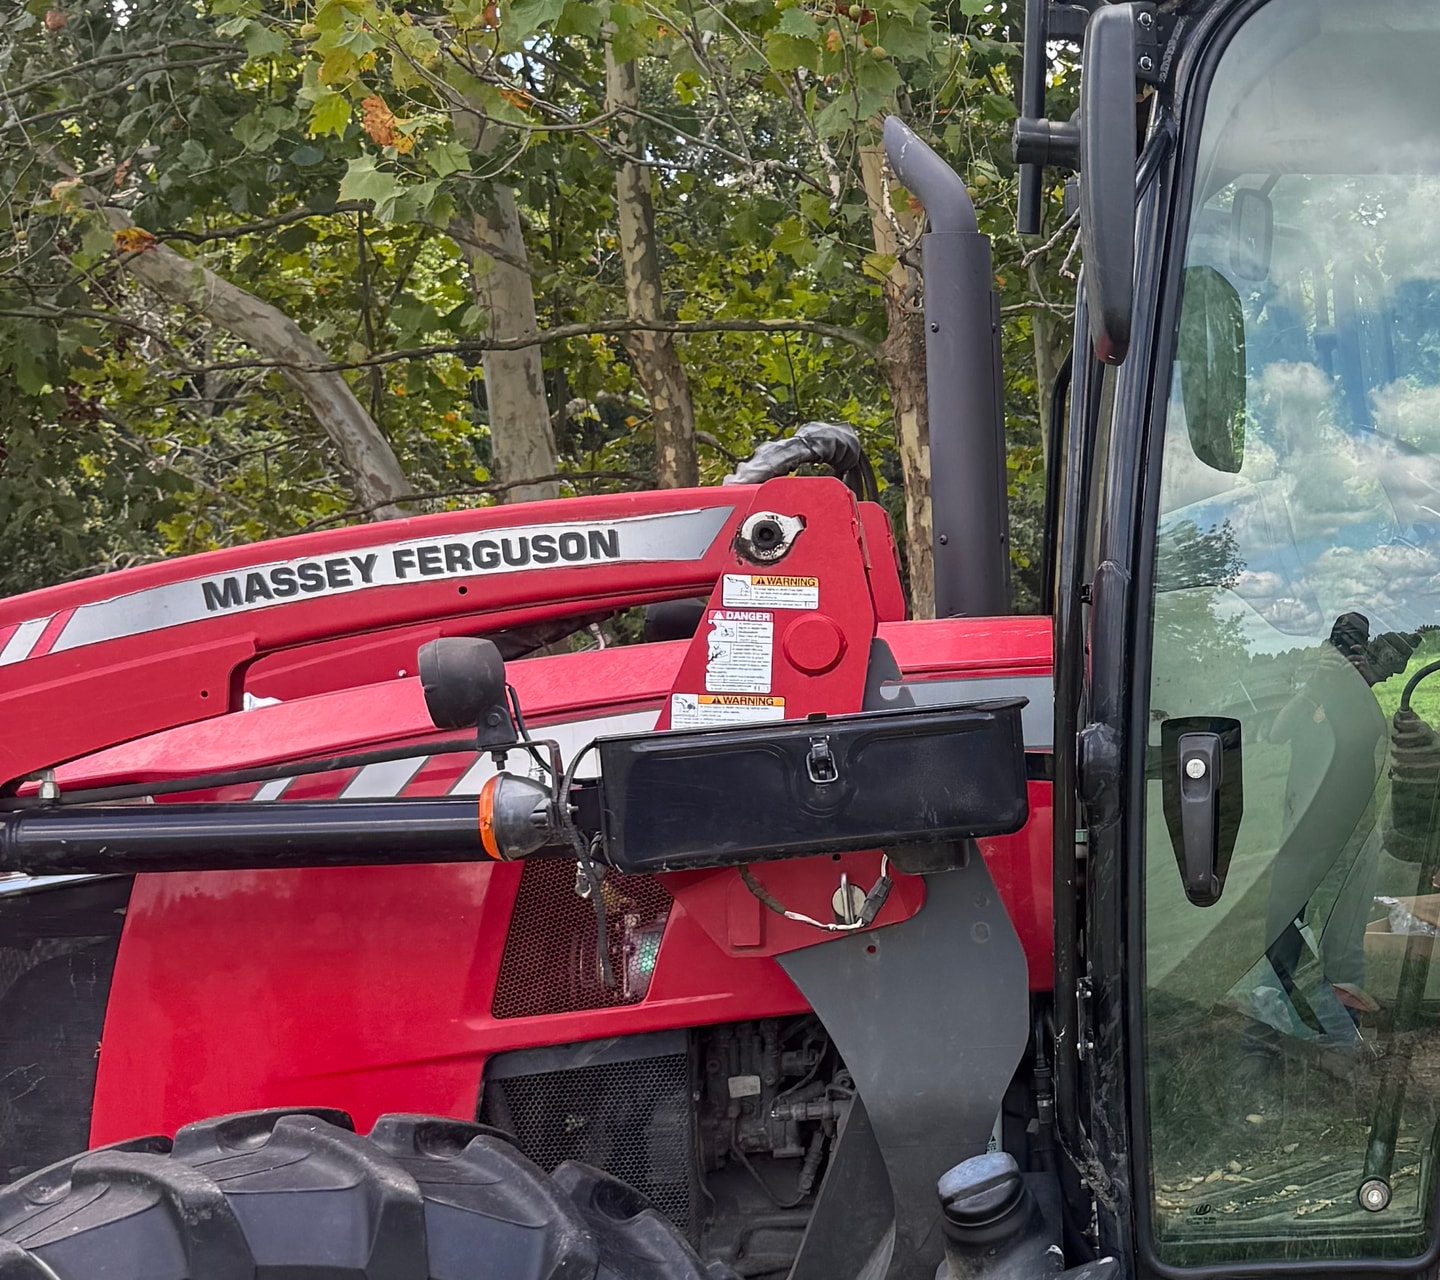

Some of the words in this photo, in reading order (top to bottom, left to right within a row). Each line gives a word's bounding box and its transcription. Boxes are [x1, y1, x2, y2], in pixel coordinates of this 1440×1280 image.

[201, 553, 377, 611] MASSEY
[393, 529, 620, 579] FERGUSON
[766, 577, 816, 587] WARNING
[726, 611, 771, 621] DANGER
[723, 697, 774, 706] WARNING
